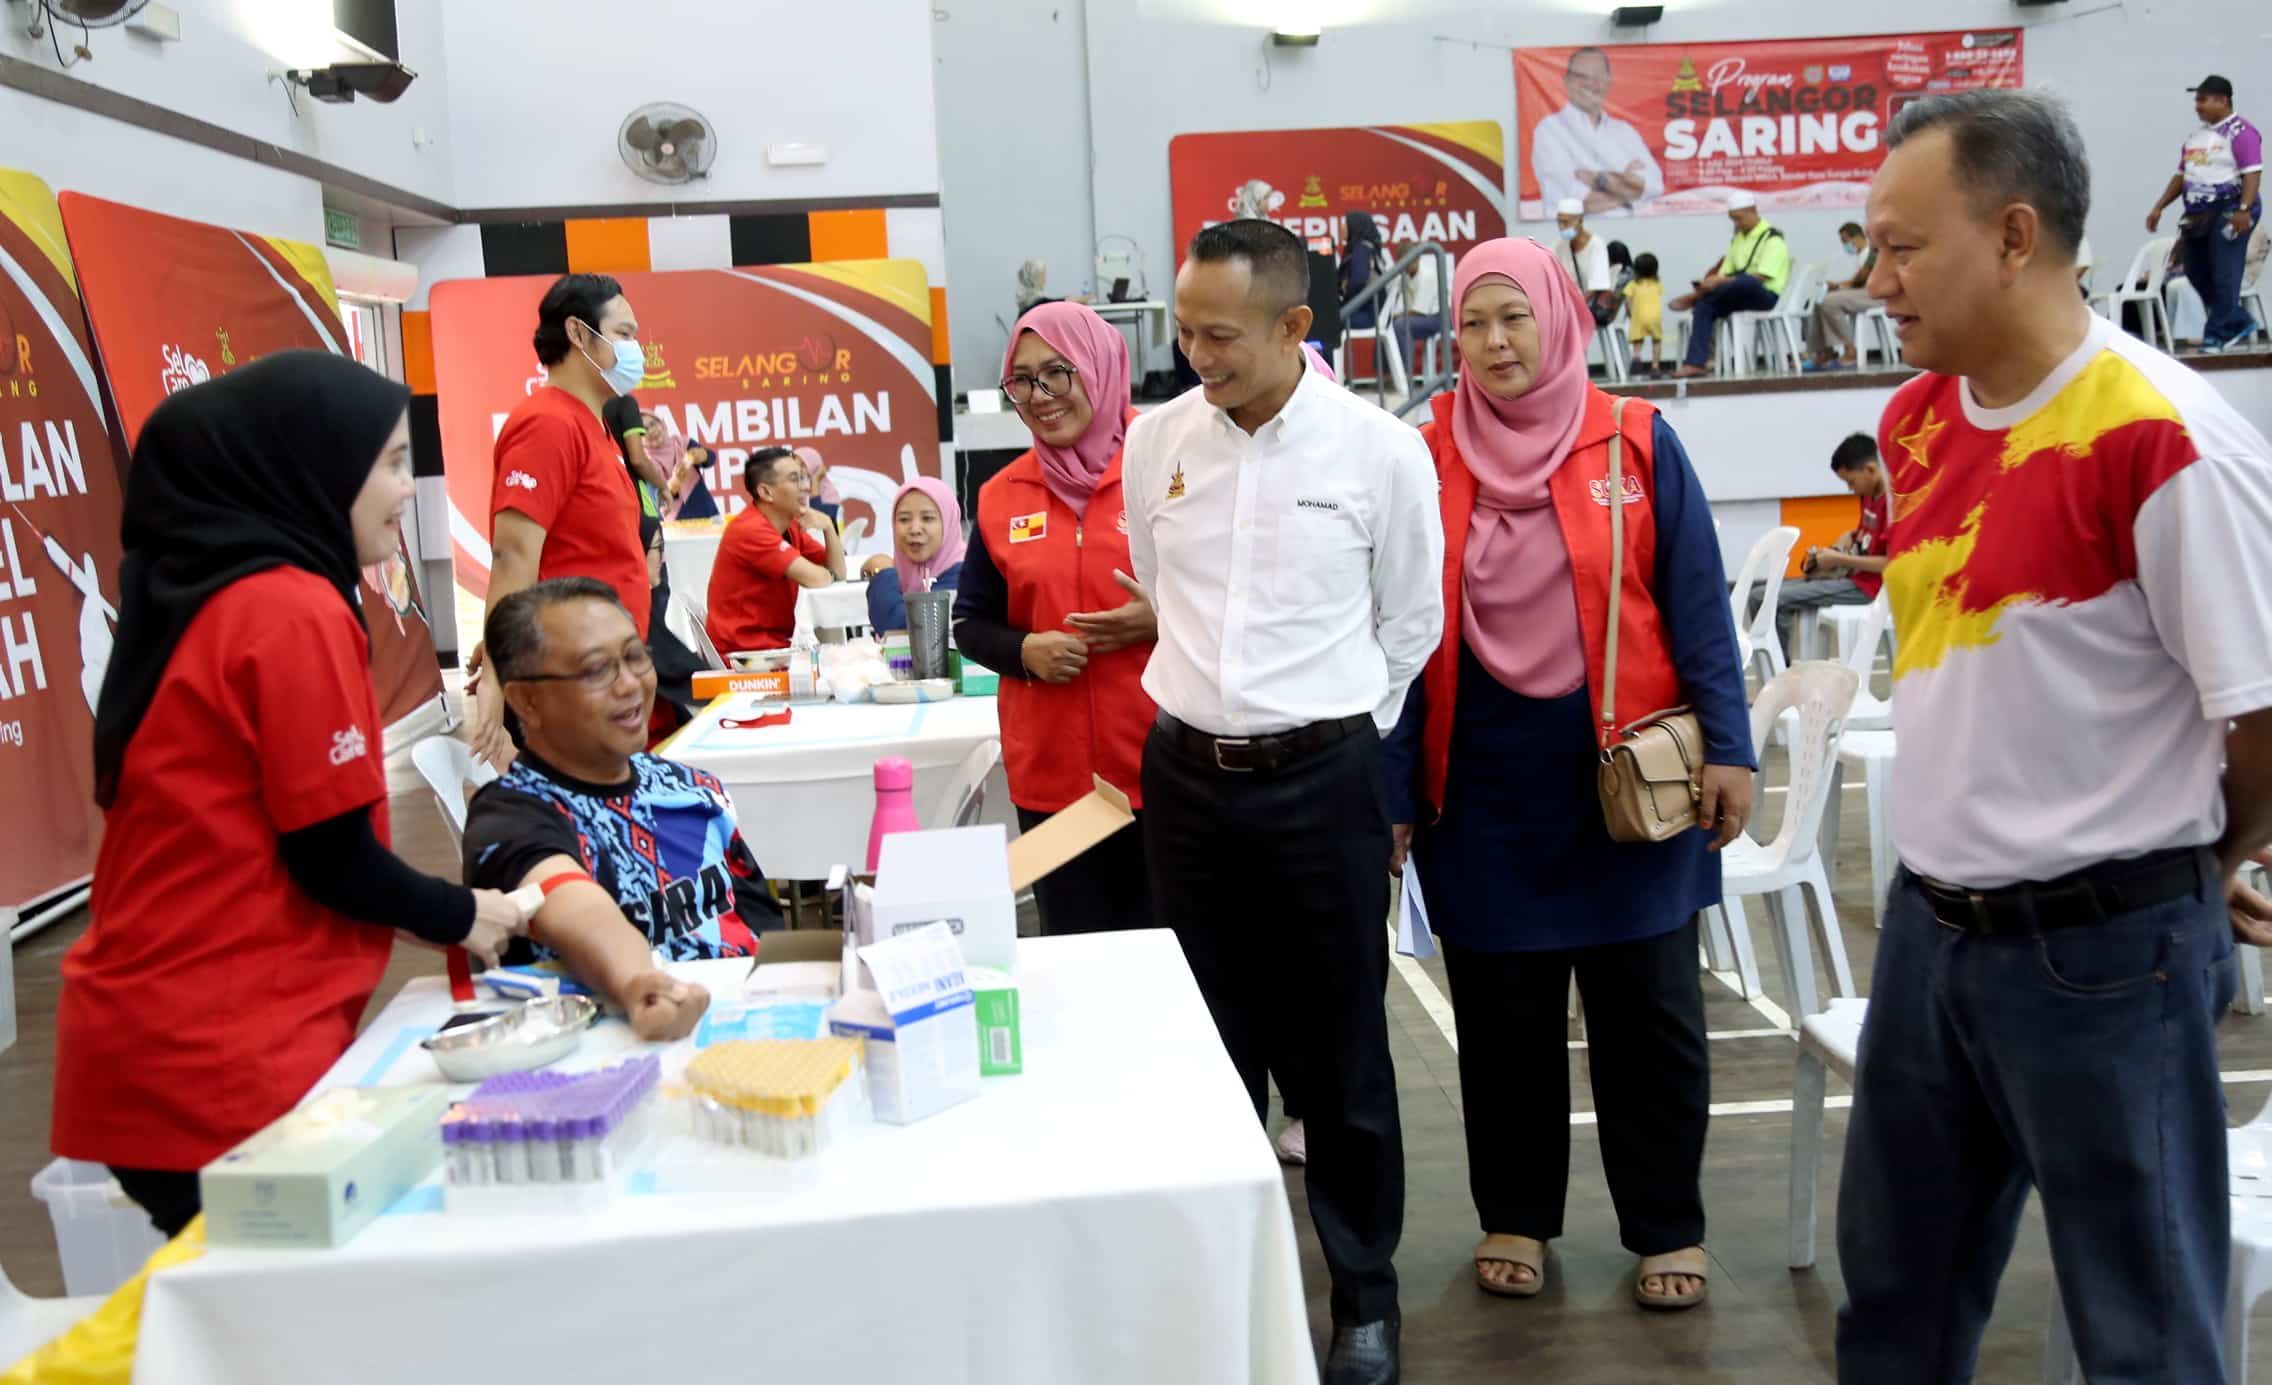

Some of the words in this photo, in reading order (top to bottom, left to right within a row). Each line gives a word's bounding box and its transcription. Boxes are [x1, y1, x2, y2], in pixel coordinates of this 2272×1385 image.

[1707, 57, 1794, 104] Program
[1665, 83, 1878, 119] SELANGOR
[1663, 111, 1879, 160] SARING
[1297, 499, 1338, 510] MOHAMAD
[728, 677, 782, 691] DUNKIN'
